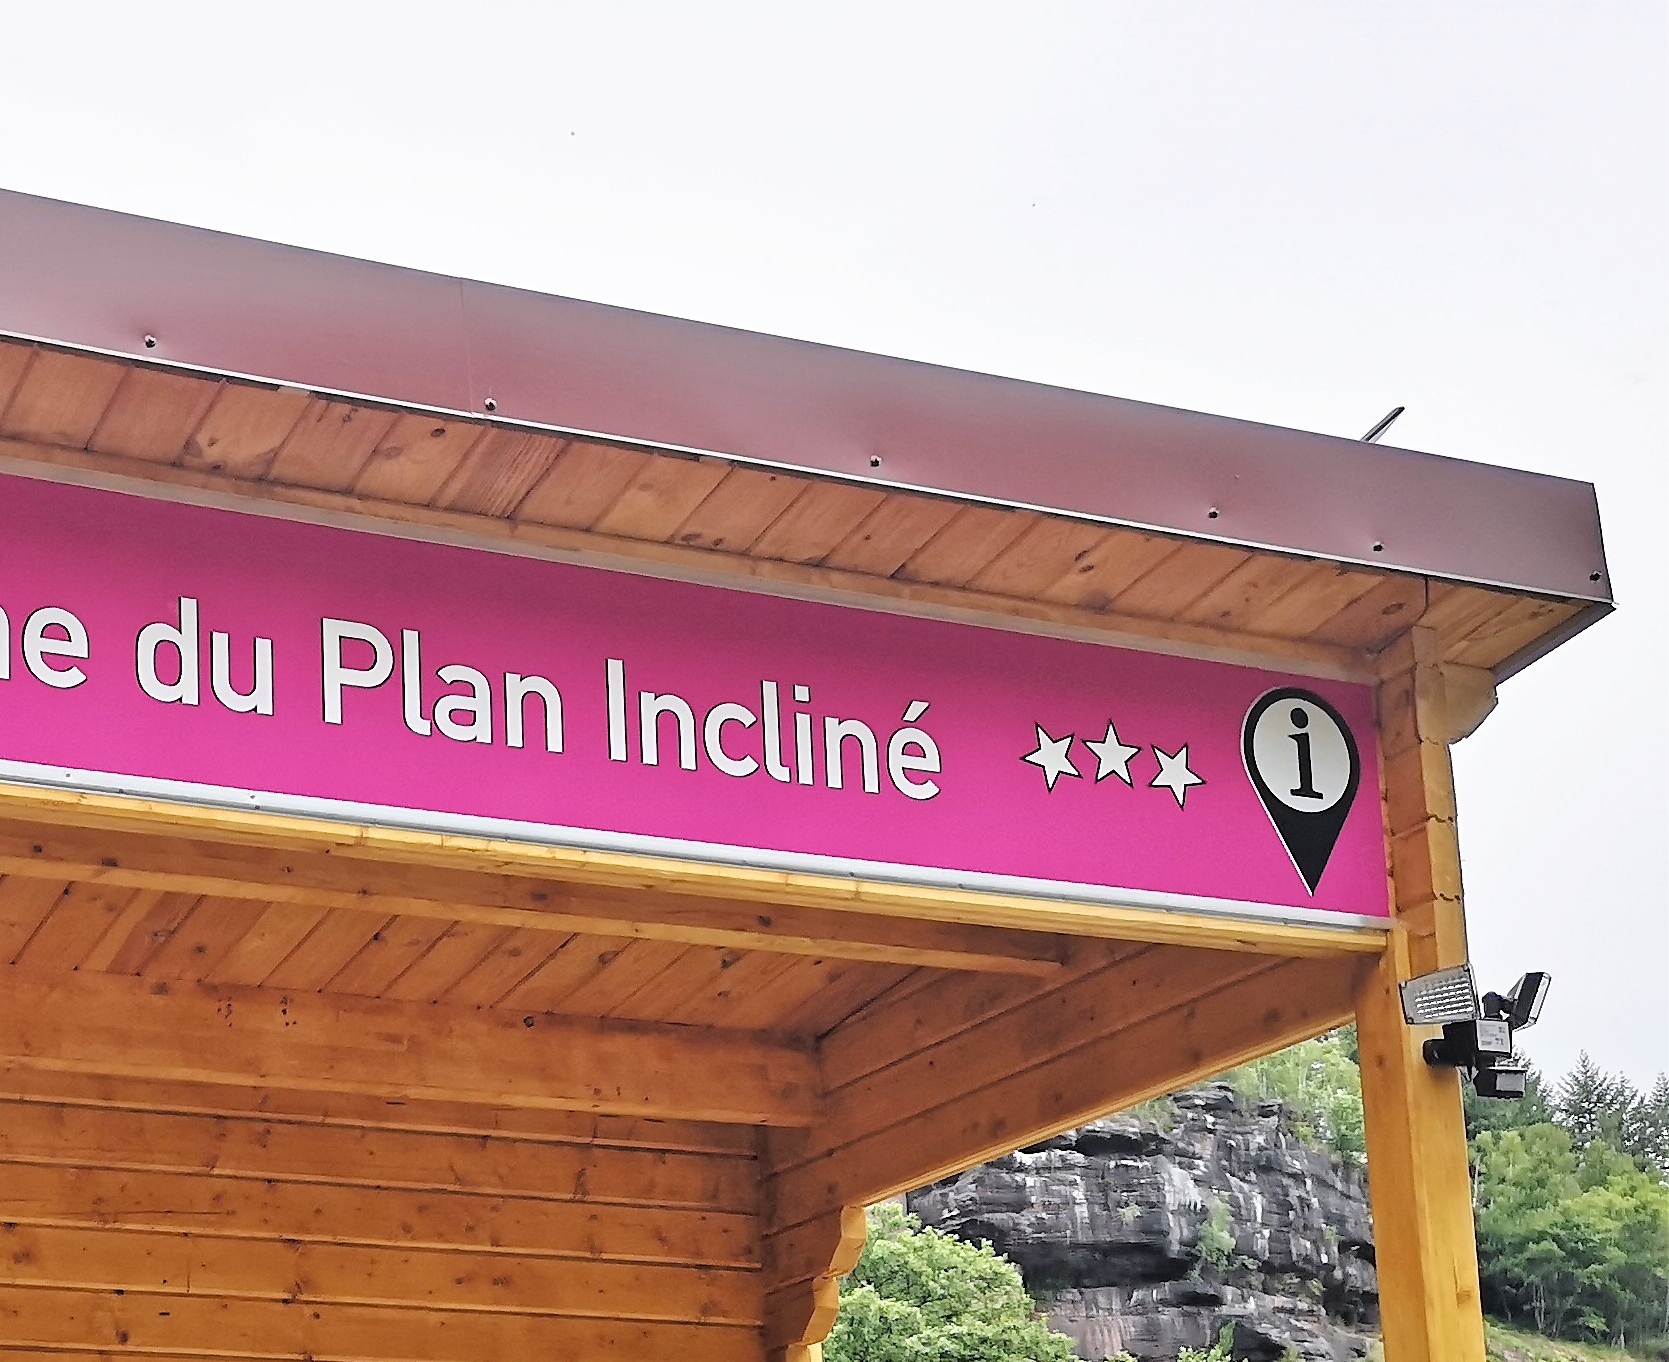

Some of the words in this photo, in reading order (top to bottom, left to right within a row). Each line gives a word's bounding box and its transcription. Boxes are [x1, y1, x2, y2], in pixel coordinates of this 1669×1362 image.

[136, 596, 274, 717] du
[320, 616, 564, 755] Plan
[605, 657, 943, 801] Incliné
